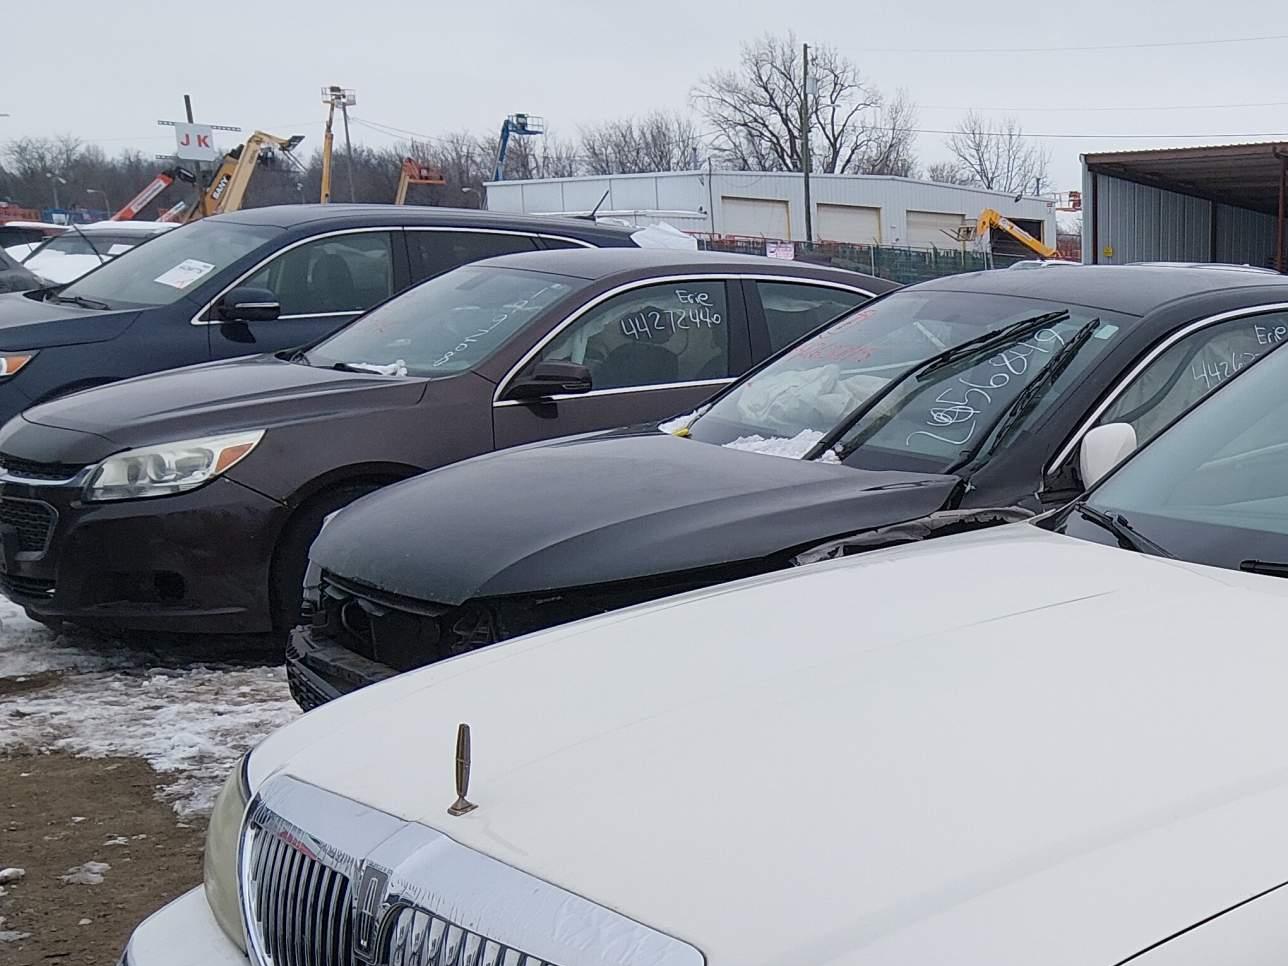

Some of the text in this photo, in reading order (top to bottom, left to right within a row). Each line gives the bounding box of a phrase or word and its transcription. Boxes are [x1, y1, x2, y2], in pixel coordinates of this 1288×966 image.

[180, 134, 210, 148] J K
[620, 307, 721, 340] 44272440
